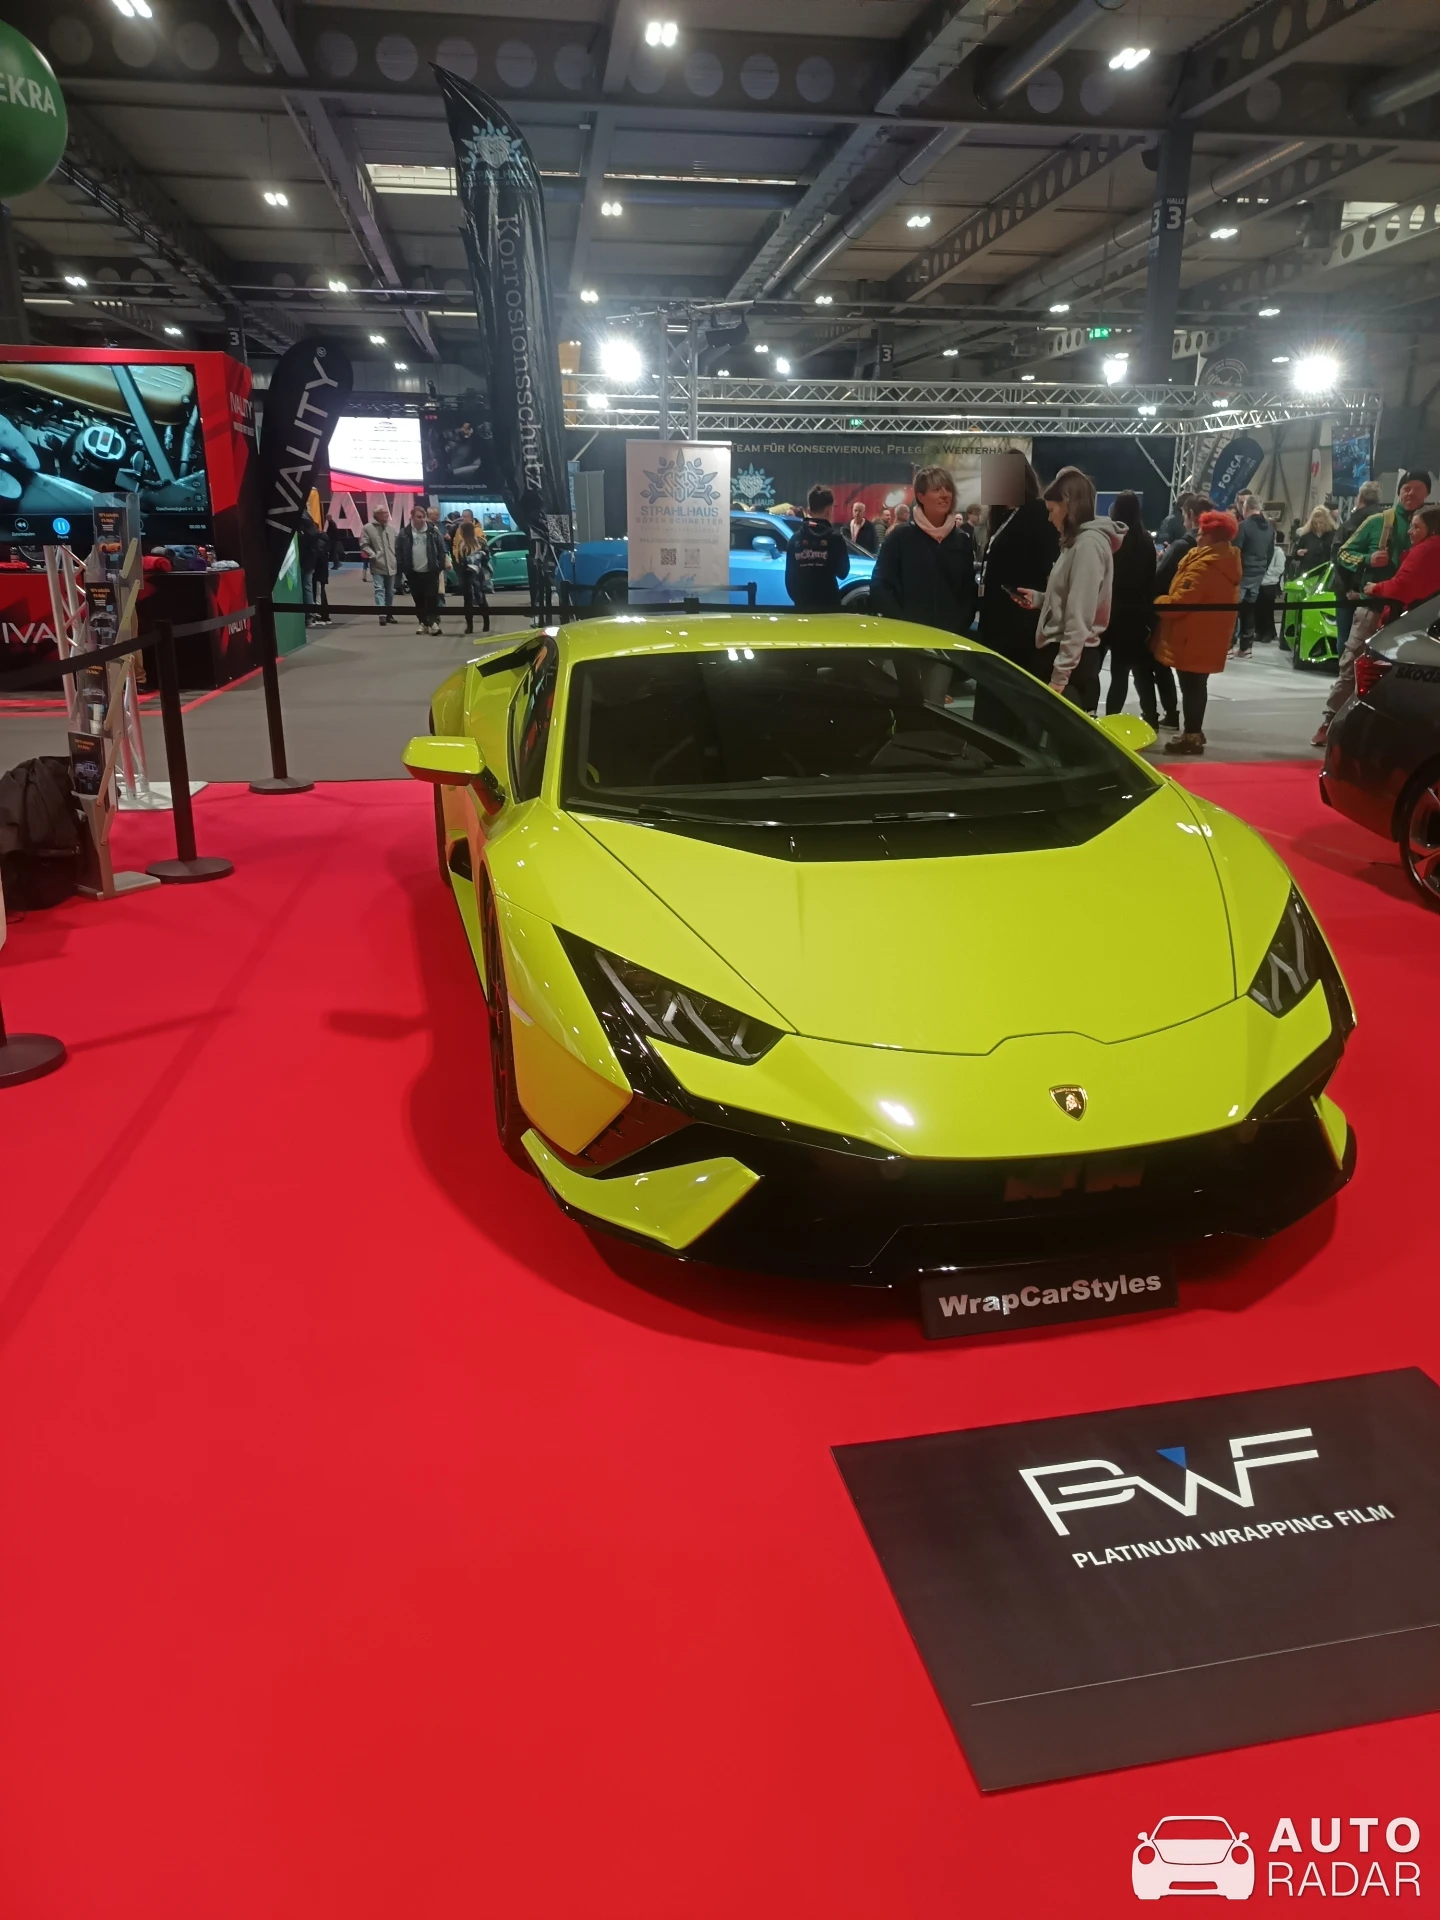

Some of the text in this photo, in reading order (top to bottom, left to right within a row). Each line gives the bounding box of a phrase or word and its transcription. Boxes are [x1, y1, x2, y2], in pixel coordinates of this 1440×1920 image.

[1151, 208, 1161, 233] 3
[1166, 205, 1182, 230] 3
[229, 331, 240, 346] 3
[495, 213, 543, 490] Korrosionsschutz
[882, 348, 892, 362] 3
[763, 442, 785, 453] FÜR
[943, 444, 1007, 455] WERTERHA
[1217, 454, 1245, 490] FORÇA
[640, 505, 719, 518] STRAHLHAUS
[670, 517, 724, 525] SCHNETTER
[1, 622, 58, 644] IVA
[938, 1274, 1162, 1317] WrapCarStyles
[1019, 1427, 1319, 1536] PWF
[1072, 1503, 1395, 1568] PLATINUM WRAPPING FILM
